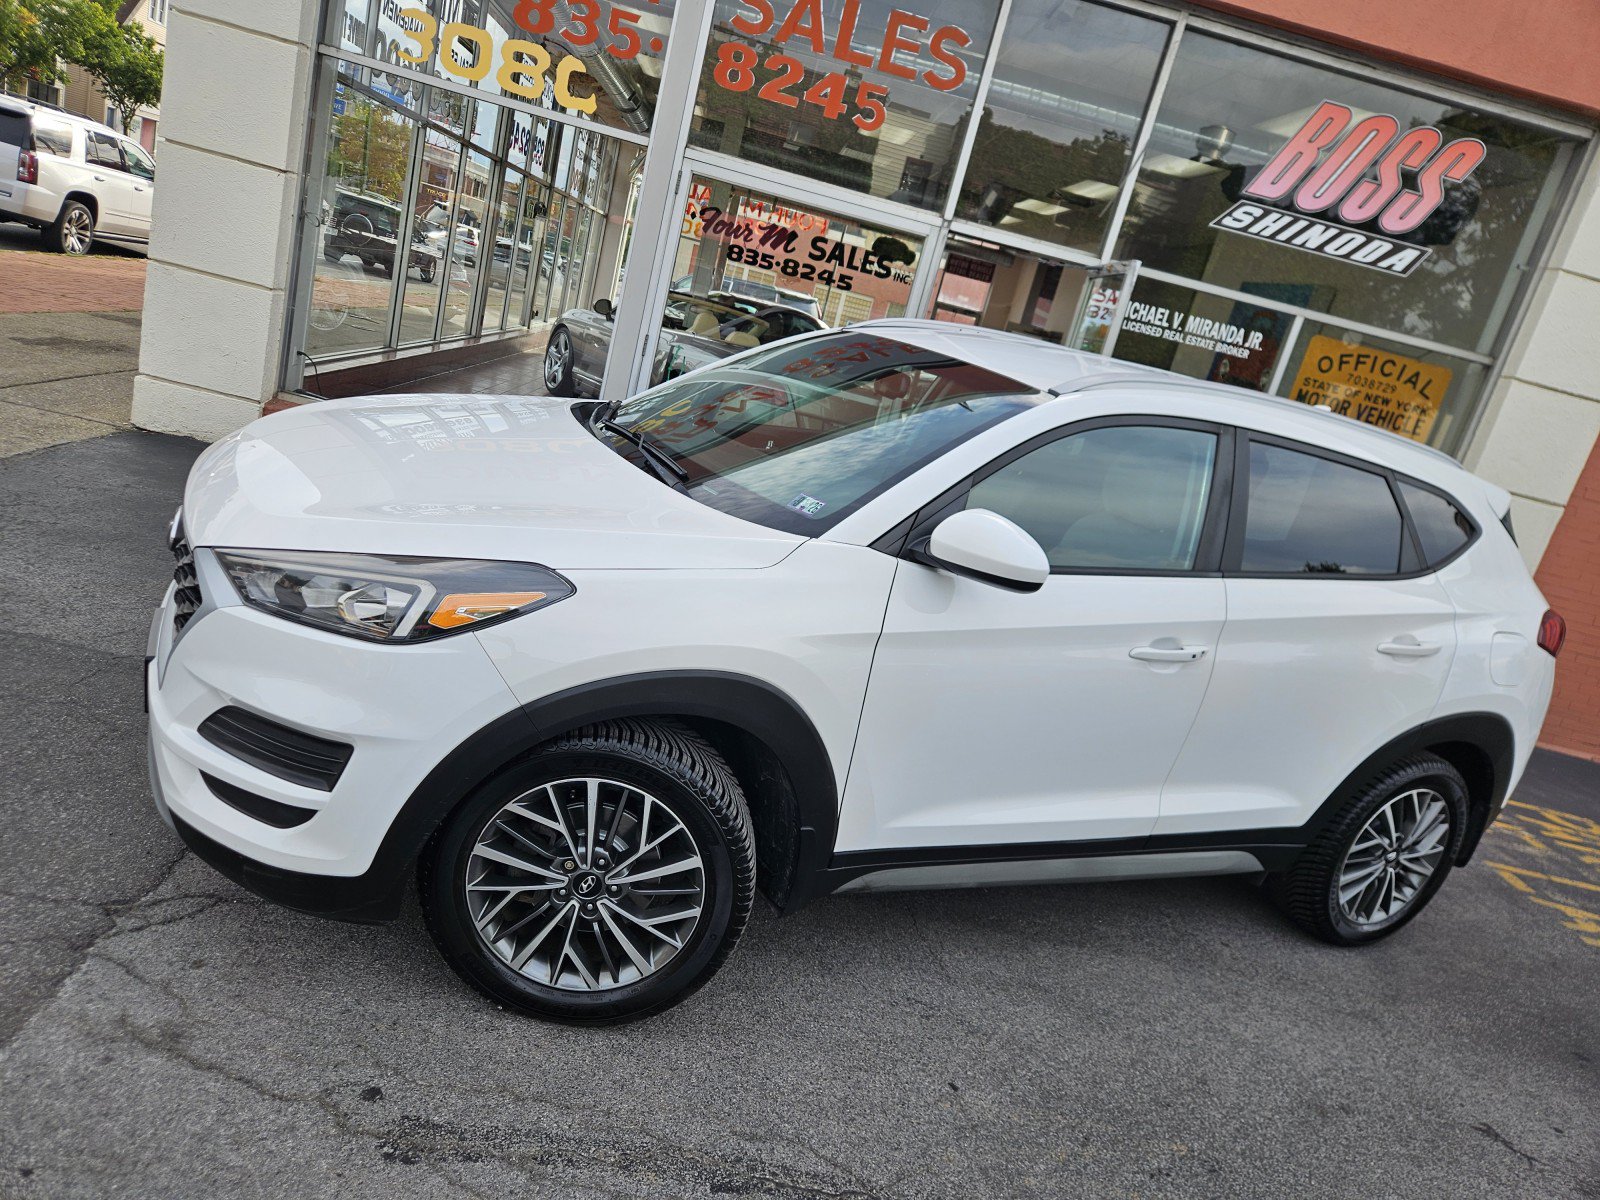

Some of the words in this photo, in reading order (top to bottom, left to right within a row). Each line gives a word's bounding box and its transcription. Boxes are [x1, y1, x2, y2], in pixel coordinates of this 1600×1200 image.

[713, 42, 890, 132] 8245
[1242, 98, 1487, 235] BOSS
[698, 206, 754, 243] Four
[757, 223, 800, 254] M
[807, 235, 894, 280] SALES
[893, 271, 913, 287] INC.
[1220, 204, 1421, 274] SHINODA
[1122, 319, 1163, 338] LICENSED
[1163, 329, 1184, 344] REAL
[1185, 335, 1215, 351] ESTATE
[1215, 342, 1251, 360] BROKER
[1173, 311, 1185, 331] V.
[1186, 315, 1245, 346] MIRANDA
[1245, 329, 1264, 352] JR.
[1302, 376, 1341, 395] STATE
[1344, 386, 1361, 398] OF
[1364, 391, 1391, 407] NEW
[1396, 400, 1430, 417] YORK
[1317, 353, 1434, 401] OFFICIAL
[1296, 388, 1352, 416] MOTOR
[1356, 402, 1427, 436] VEHICLE
